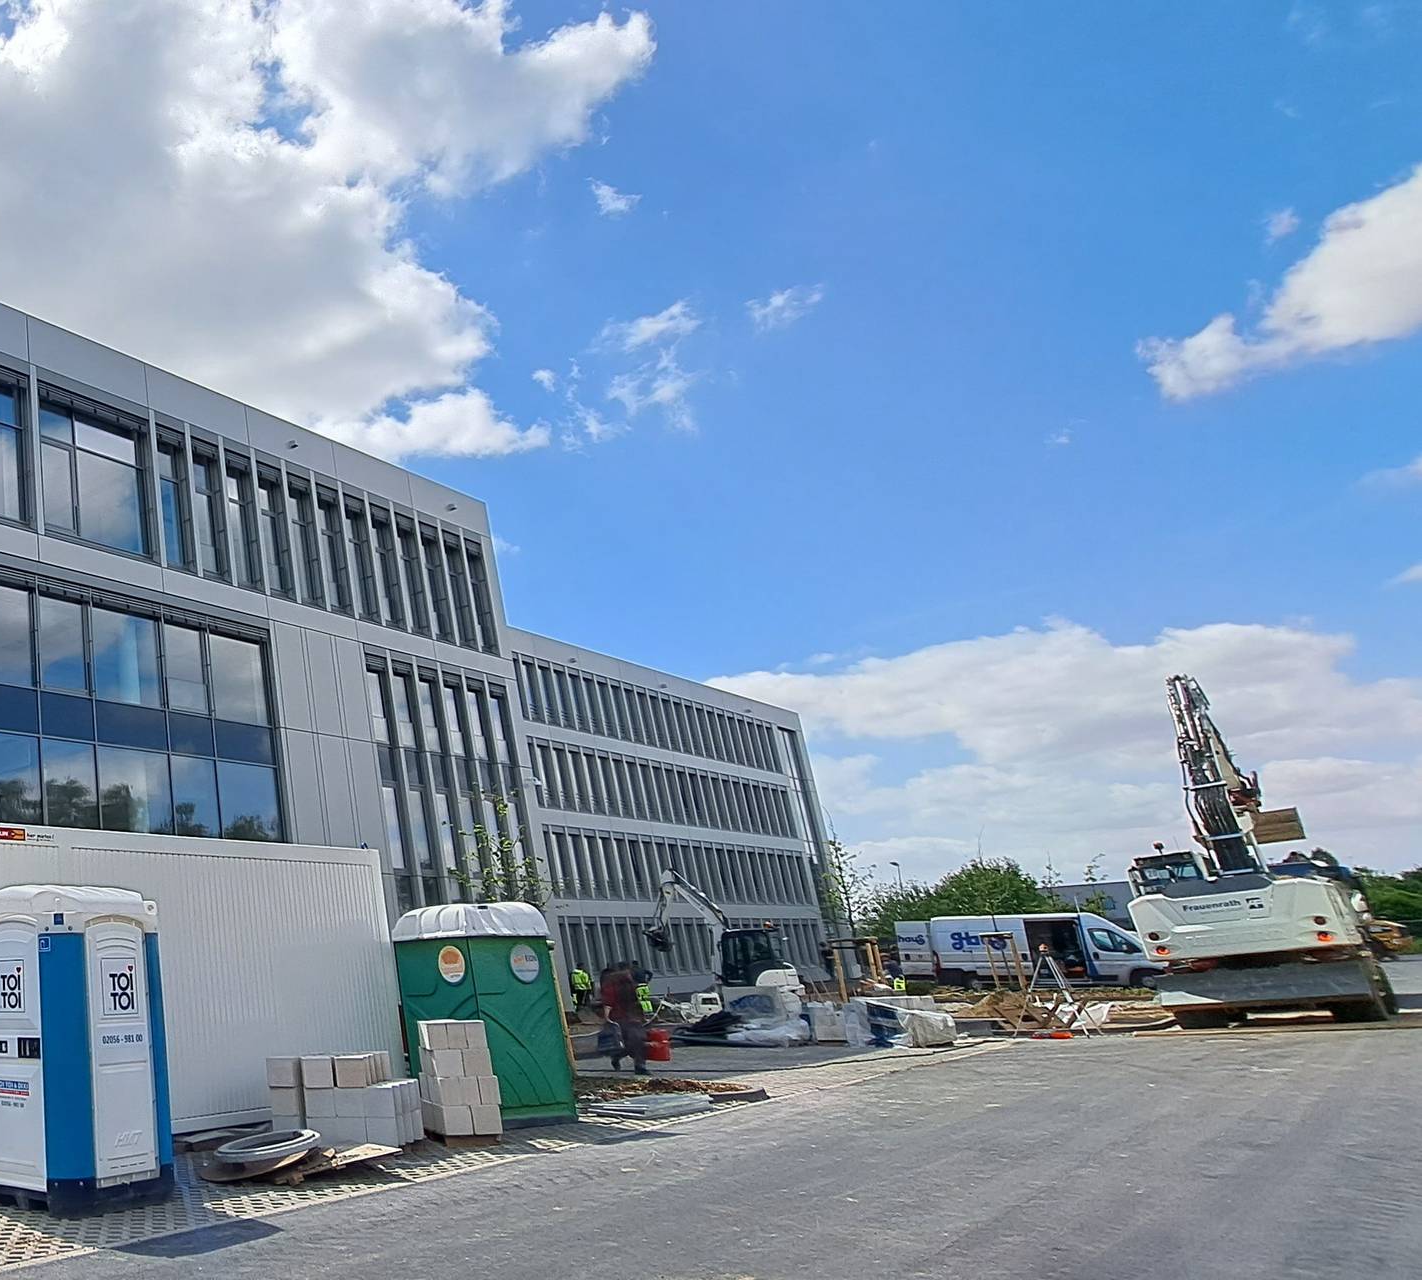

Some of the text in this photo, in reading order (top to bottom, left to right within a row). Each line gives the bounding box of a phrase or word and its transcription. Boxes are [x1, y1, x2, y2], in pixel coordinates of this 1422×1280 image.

[1182, 900, 1241, 911] Frauenrath
[0, 974, 21, 991] TOI
[109, 972, 134, 991] TOI
[0, 991, 21, 1009] TOI
[110, 991, 135, 1010] TOI
